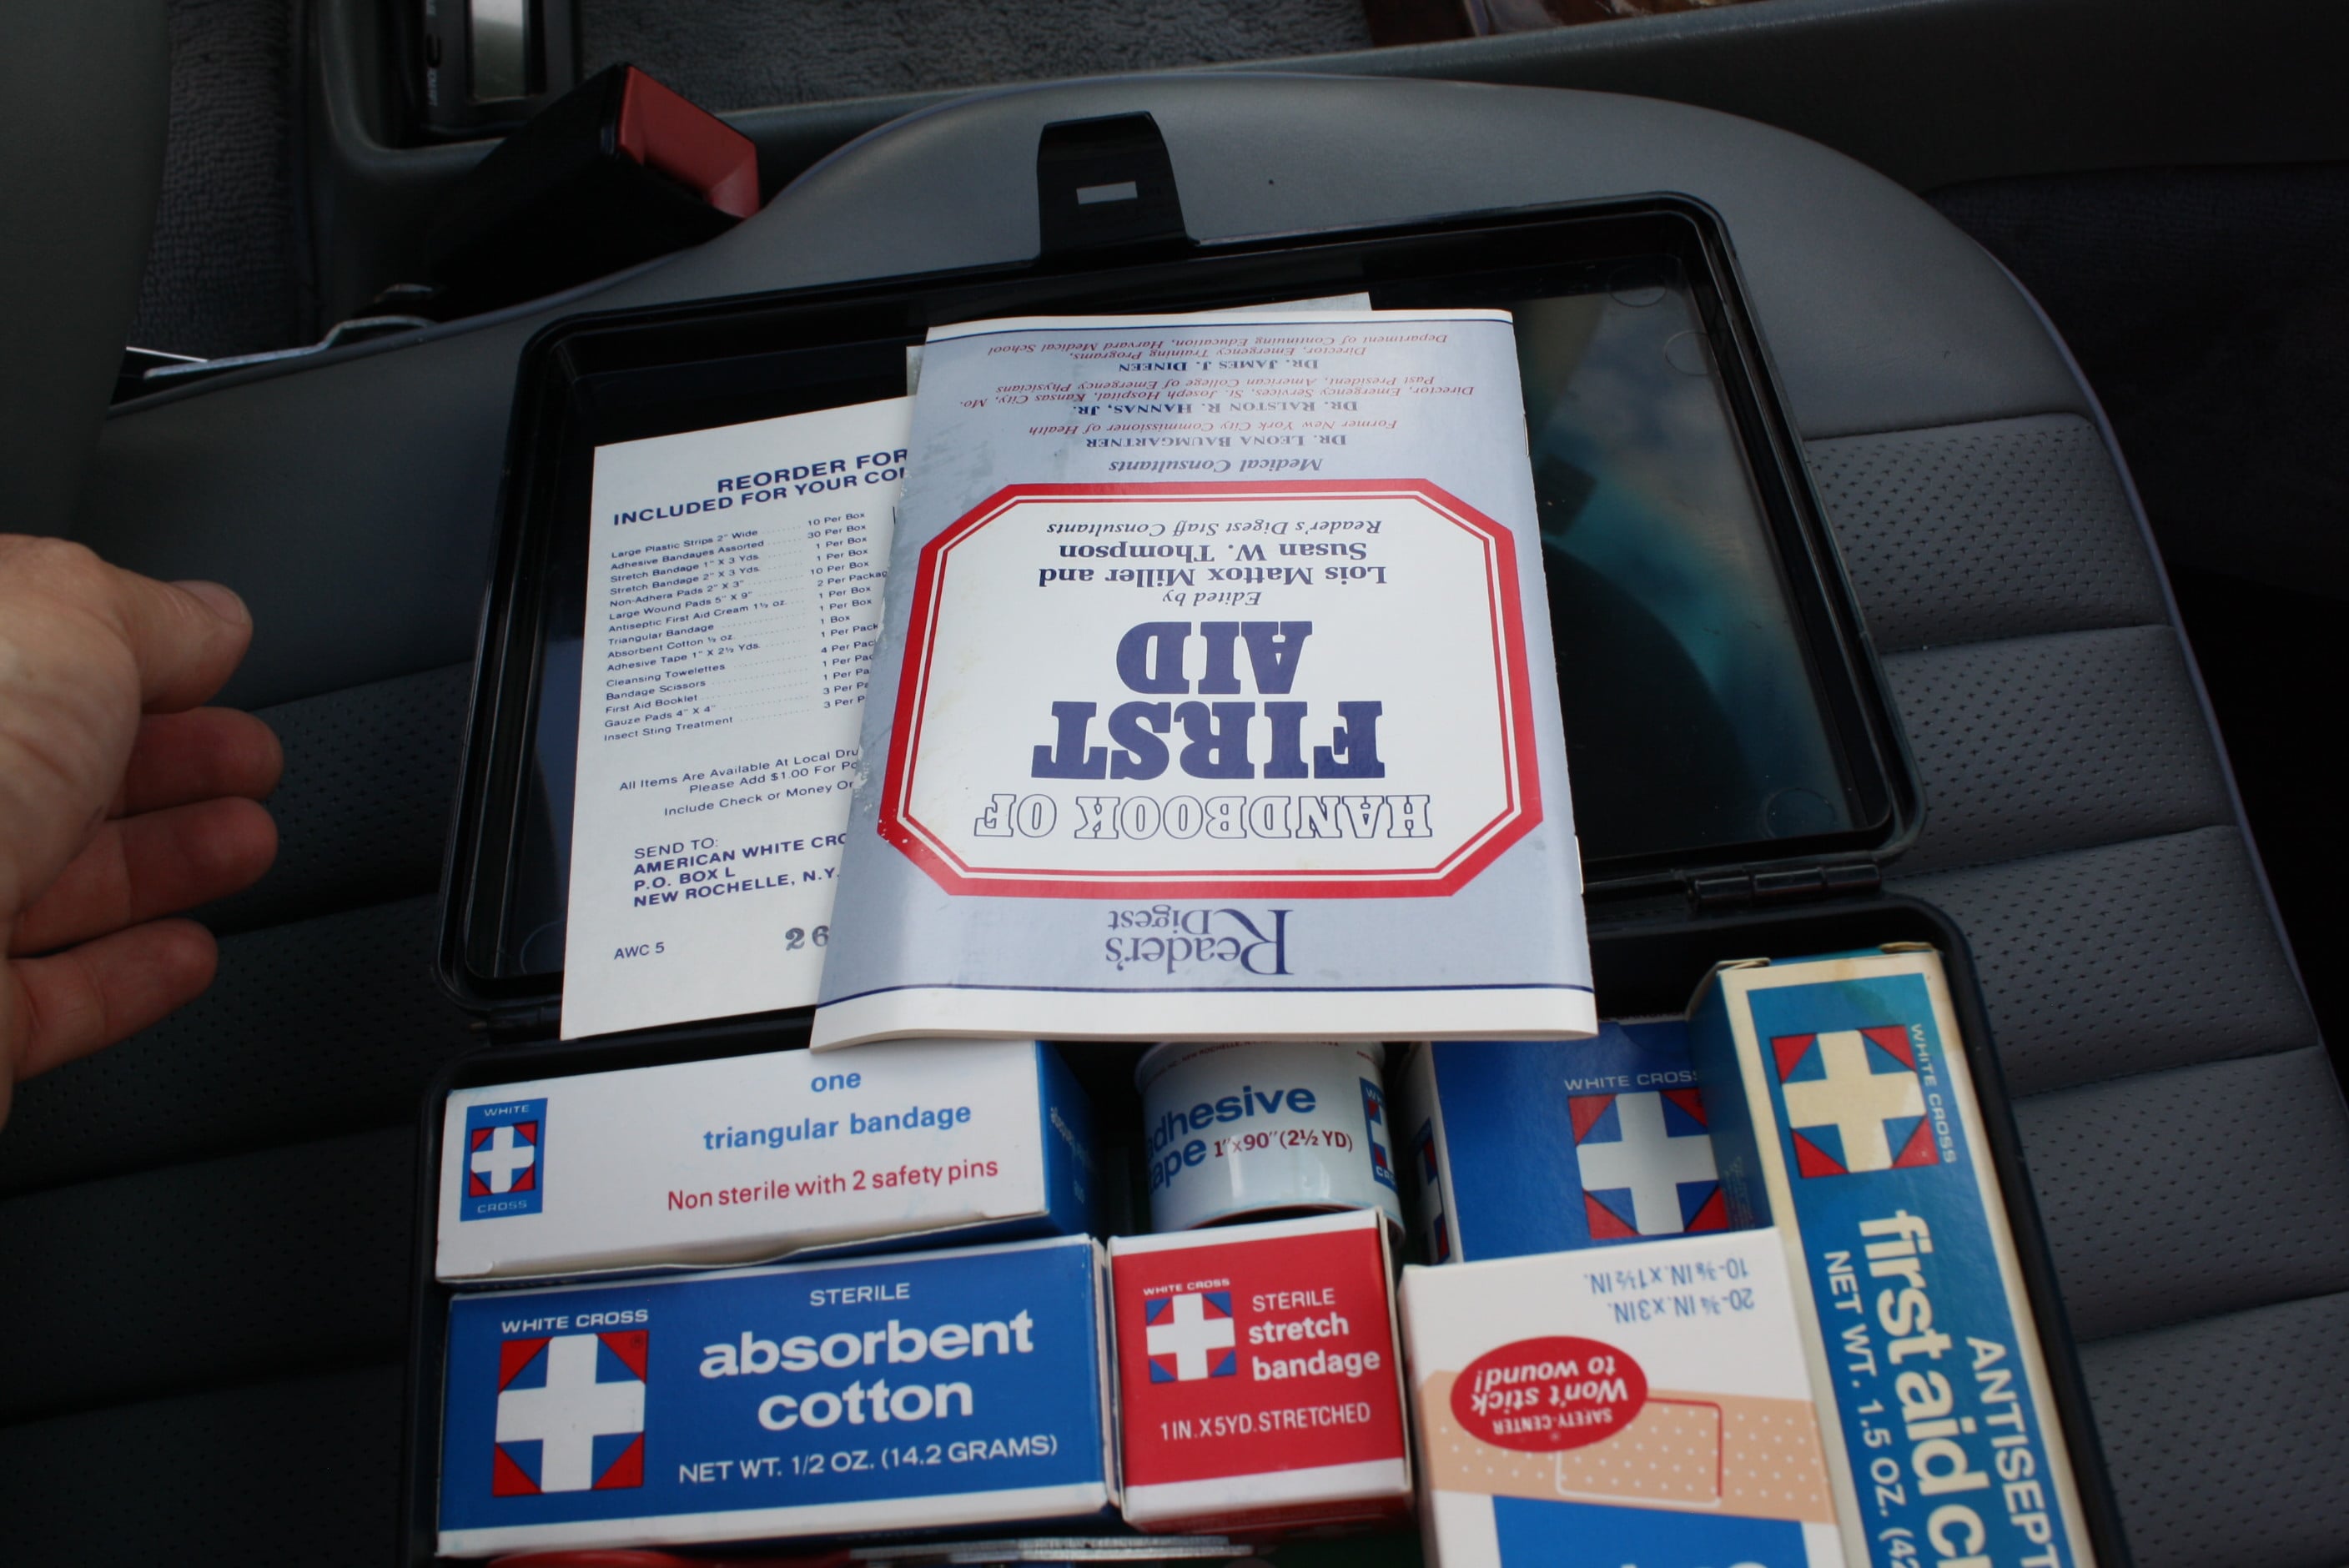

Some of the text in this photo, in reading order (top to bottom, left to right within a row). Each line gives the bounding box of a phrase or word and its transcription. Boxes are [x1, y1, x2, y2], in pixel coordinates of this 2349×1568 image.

[1149, 347, 1208, 358] Training
[1196, 361, 1212, 371] J.
[1216, 347, 1295, 358] Emergency
[1201, 403, 1220, 413] R.
[1029, 420, 1397, 435] Former New York City Commissioner of Health
[717, 459, 846, 493] REORDER
[856, 449, 908, 470] FOR
[1108, 458, 1323, 473] Medical Consultants
[613, 497, 733, 525] INCLUDED
[741, 486, 787, 506] FOR
[795, 475, 857, 495] YOUR
[807, 525, 866, 539] 30 Per Box
[1046, 519, 1381, 537] Reader's Digest Staff Consultants
[610, 558, 658, 570] Adhesive
[718, 540, 764, 554] Assorted
[611, 548, 641, 558] Large
[645, 543, 681, 553] Plastic
[683, 537, 713, 548] Strips
[732, 530, 758, 539] Wide
[1059, 540, 1366, 563] Susan W. Thompson
[1039, 565, 1386, 588] Lois Mattox Miller and
[1162, 589, 1261, 607] Edited by
[608, 624, 714, 646] Triangular Bandage
[1115, 621, 1313, 694] AID
[605, 694, 697, 714] First Aid Booklet
[603, 716, 732, 741] Insect Sting Treatment
[1030, 701, 1386, 780] FIRST
[619, 780, 636, 791] All
[640, 776, 678, 788] Items
[682, 772, 705, 782] Are
[710, 761, 770, 778] Available
[774, 758, 788, 767] At
[793, 751, 830, 766] Local
[835, 748, 858, 764] Dru
[689, 780, 735, 794] Please
[740, 774, 766, 787] Add
[813, 764, 836, 775] For
[664, 802, 714, 816] Include
[718, 793, 762, 808] Check
[767, 792, 780, 801] or
[785, 785, 832, 797] Money
[973, 792, 1433, 840] HANDBOOK OF
[633, 850, 735, 875] AMERICAN
[741, 839, 804, 858] WHITE
[634, 842, 684, 859] SEND
[633, 867, 736, 892] P.O. BOX L
[633, 890, 679, 907] NEW
[685, 874, 795, 900] ROCHELLE,
[1108, 904, 1213, 935] Digest
[613, 941, 665, 960] AWC 5
[1105, 908, 1295, 976] Reader's
[810, 1072, 861, 1093] one
[1563, 1070, 1697, 1091] WHITE CROS
[1911, 1024, 1957, 1163] WHITE CROSS
[484, 1103, 529, 1117] WHITE
[702, 1106, 971, 1150] triangular bandage
[667, 1159, 998, 1210] Non sterile with 2 safety pins
[476, 1199, 527, 1214] CROSS
[809, 1282, 910, 1306] STERILE
[1143, 1278, 1230, 1296] WHITE CROSS
[1251, 1288, 1335, 1312] STERILE
[1859, 1209, 1952, 1364] first
[501, 1309, 648, 1334] WHITE CROSS
[1248, 1312, 1349, 1344] stretch
[698, 1313, 1034, 1377] absorbent
[1251, 1349, 1381, 1380] bandage
[1475, 1355, 1616, 1394] to wound!
[1471, 1378, 1628, 1416] Won't stick
[1824, 1250, 1906, 1517] NET WT. 1.5 OZ.
[757, 1381, 973, 1430] cotton
[1160, 1422, 1168, 1440] 1
[1258, 1402, 1371, 1431] STRETCHED
[1895, 1370, 1990, 1495] aid
[679, 1435, 1057, 1483] NET WT. 1/2 OZ. (14.2 GRAMS)
[1966, 1336, 2060, 1568] ANTISEPT
